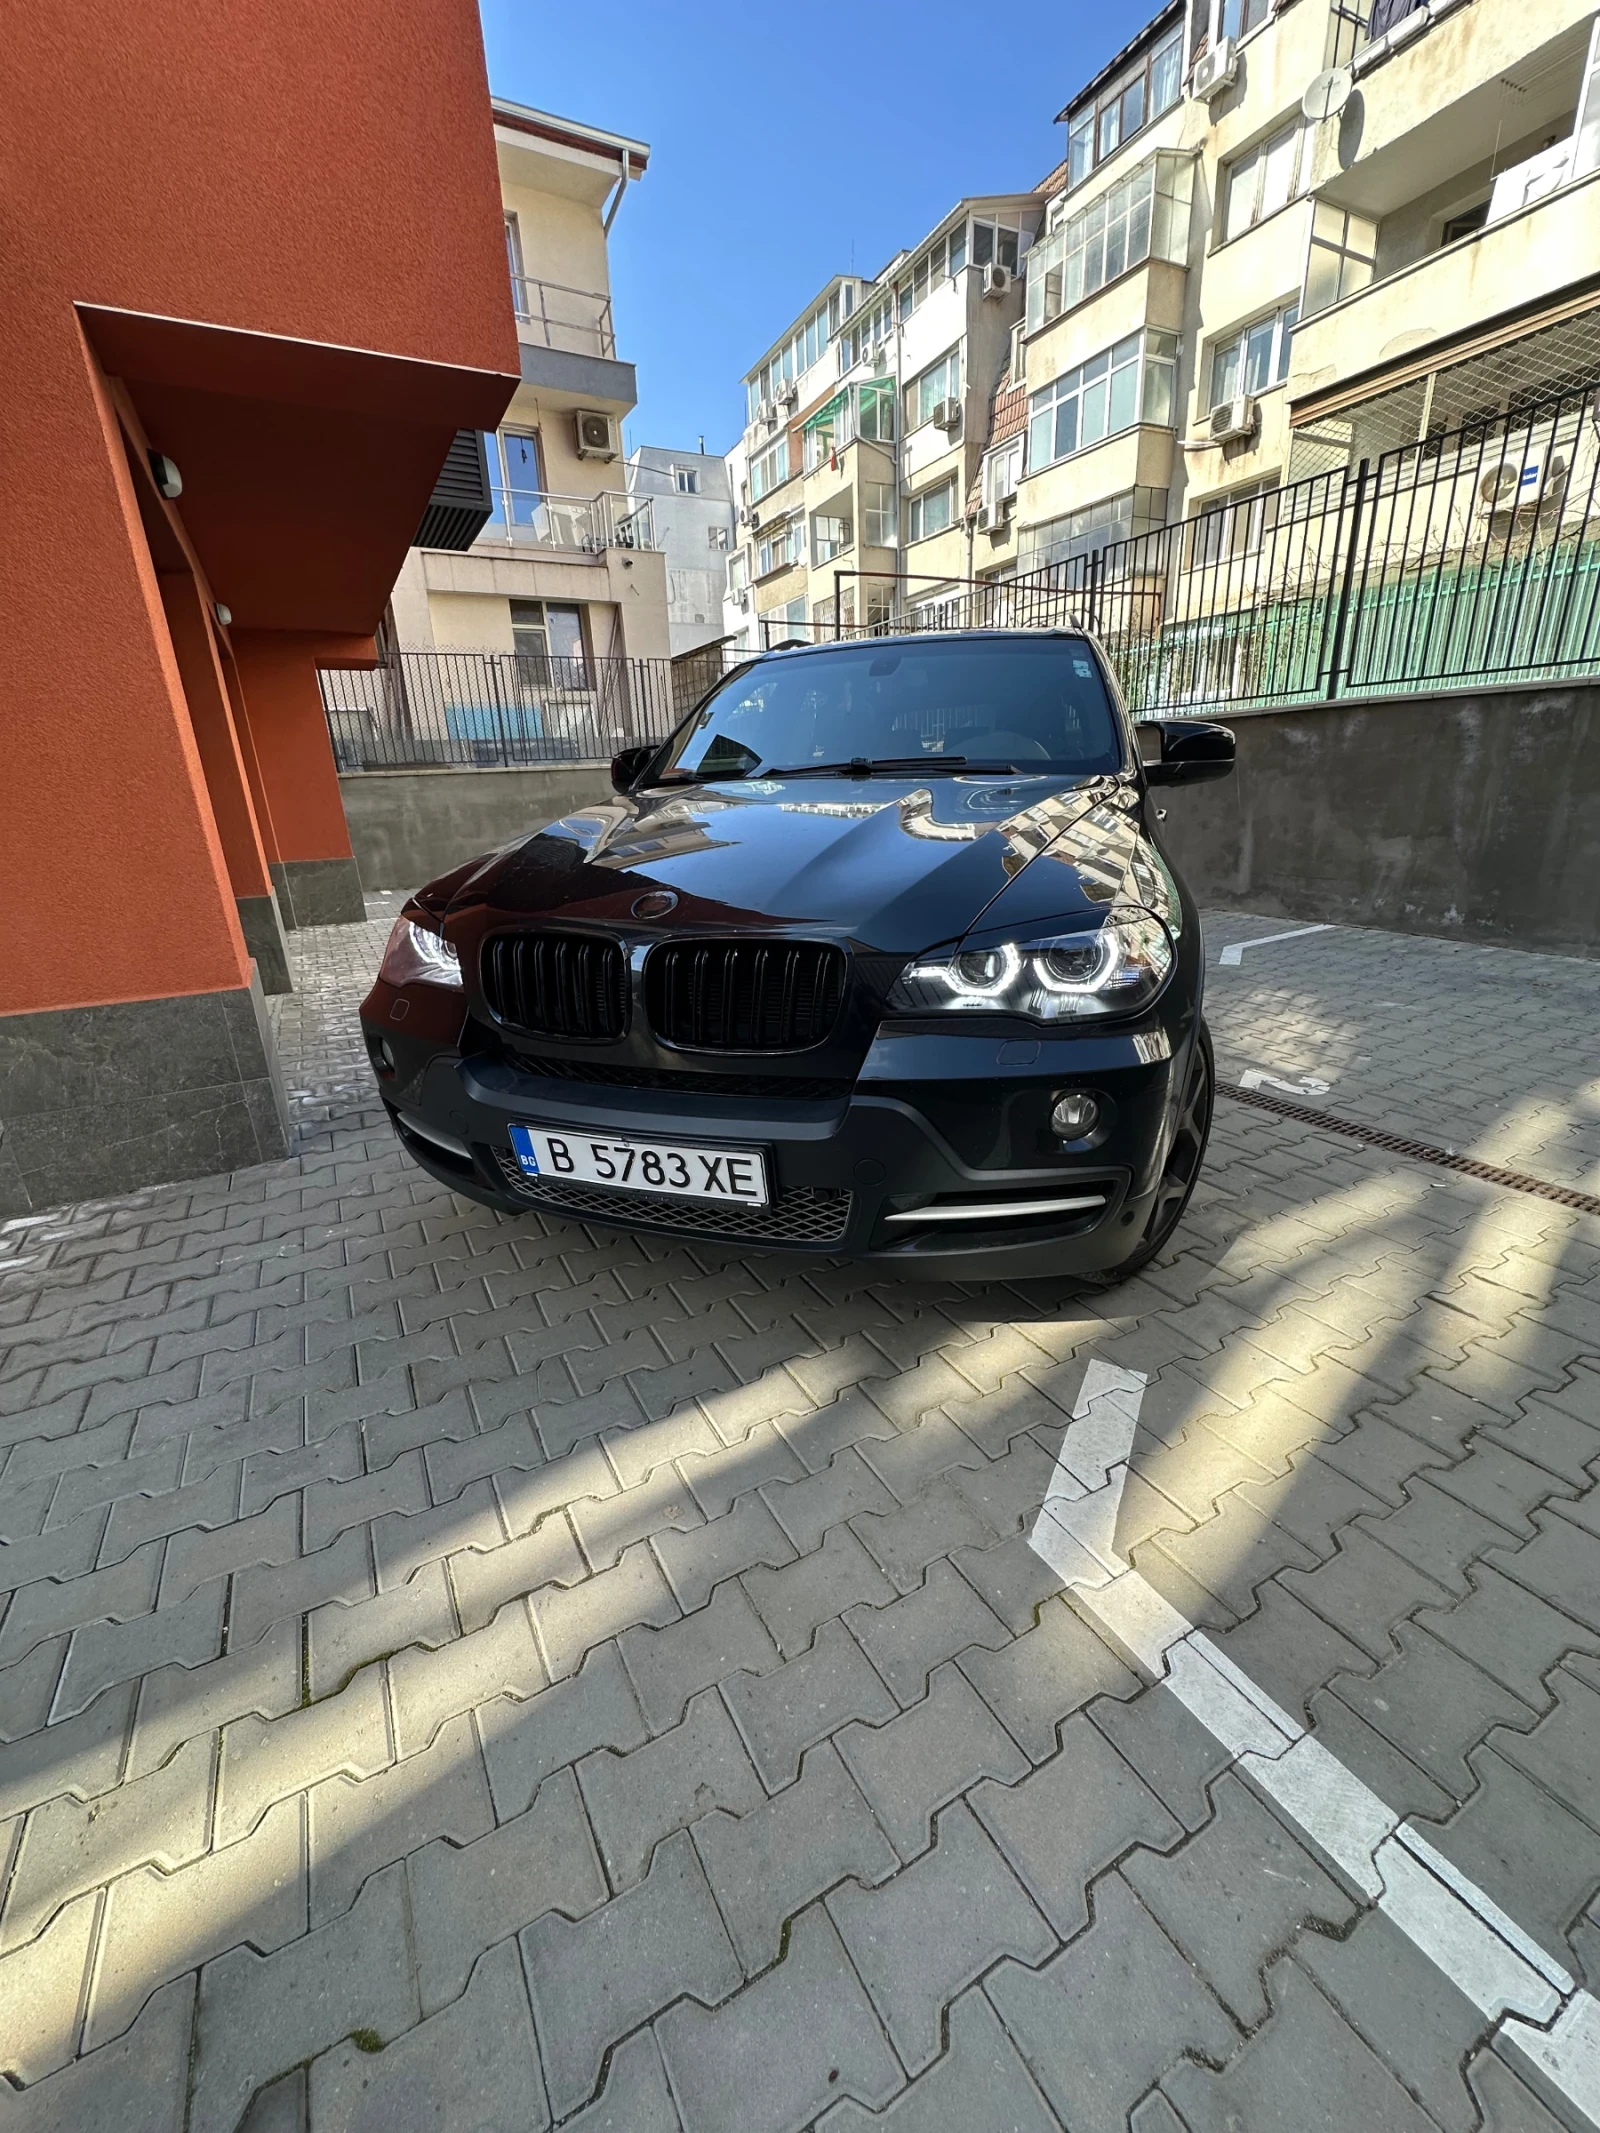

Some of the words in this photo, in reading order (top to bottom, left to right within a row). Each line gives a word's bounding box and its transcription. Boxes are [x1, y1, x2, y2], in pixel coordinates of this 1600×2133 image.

[520, 1154, 536, 1167] BG
[547, 1137, 574, 1173] B
[590, 1143, 691, 1188] 5783
[698, 1155, 758, 1196] XE
